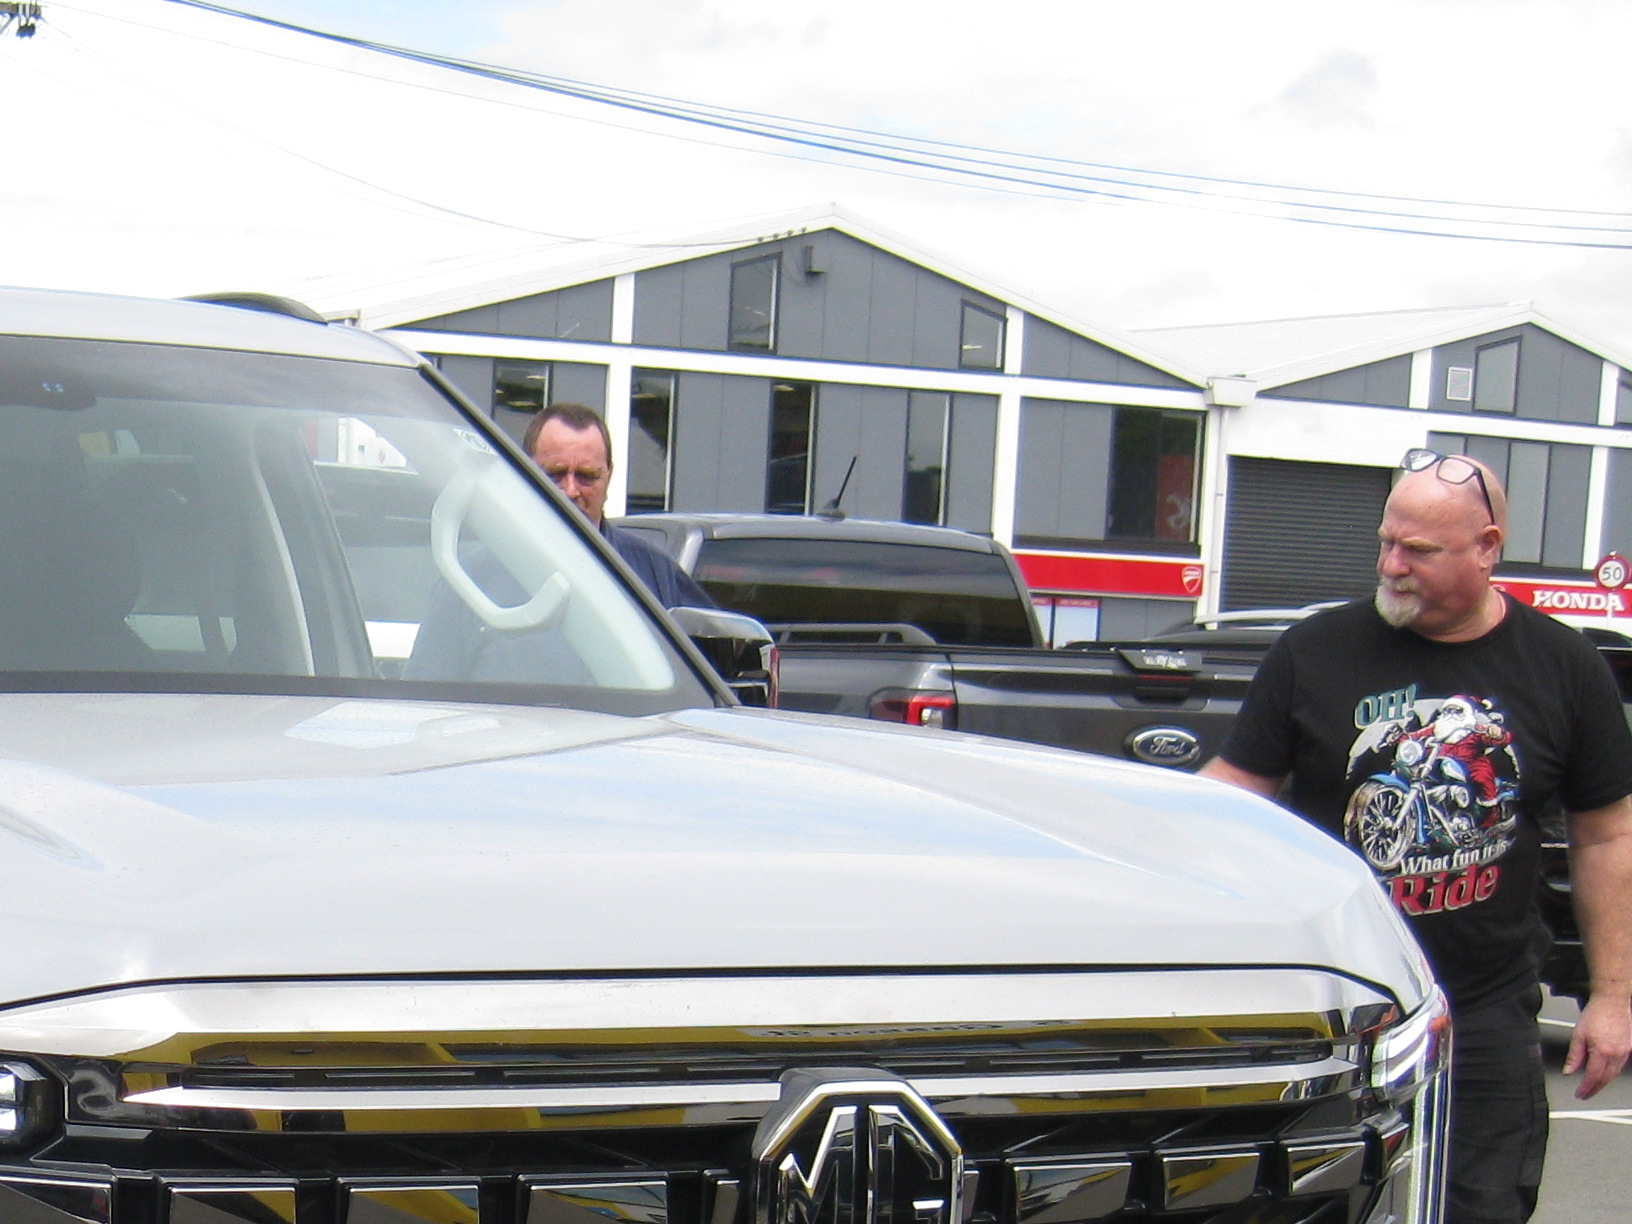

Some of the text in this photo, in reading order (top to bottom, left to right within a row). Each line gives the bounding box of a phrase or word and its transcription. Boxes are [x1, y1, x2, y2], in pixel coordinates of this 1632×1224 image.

[1601, 566, 1623, 582] 50
[1531, 590, 1625, 612] HONDA
[1354, 683, 1417, 730] OH!
[1150, 735, 1186, 756] Ford
[1400, 855, 1449, 875] What
[1451, 848, 1481, 869] fun
[1387, 863, 1501, 916] Ride
